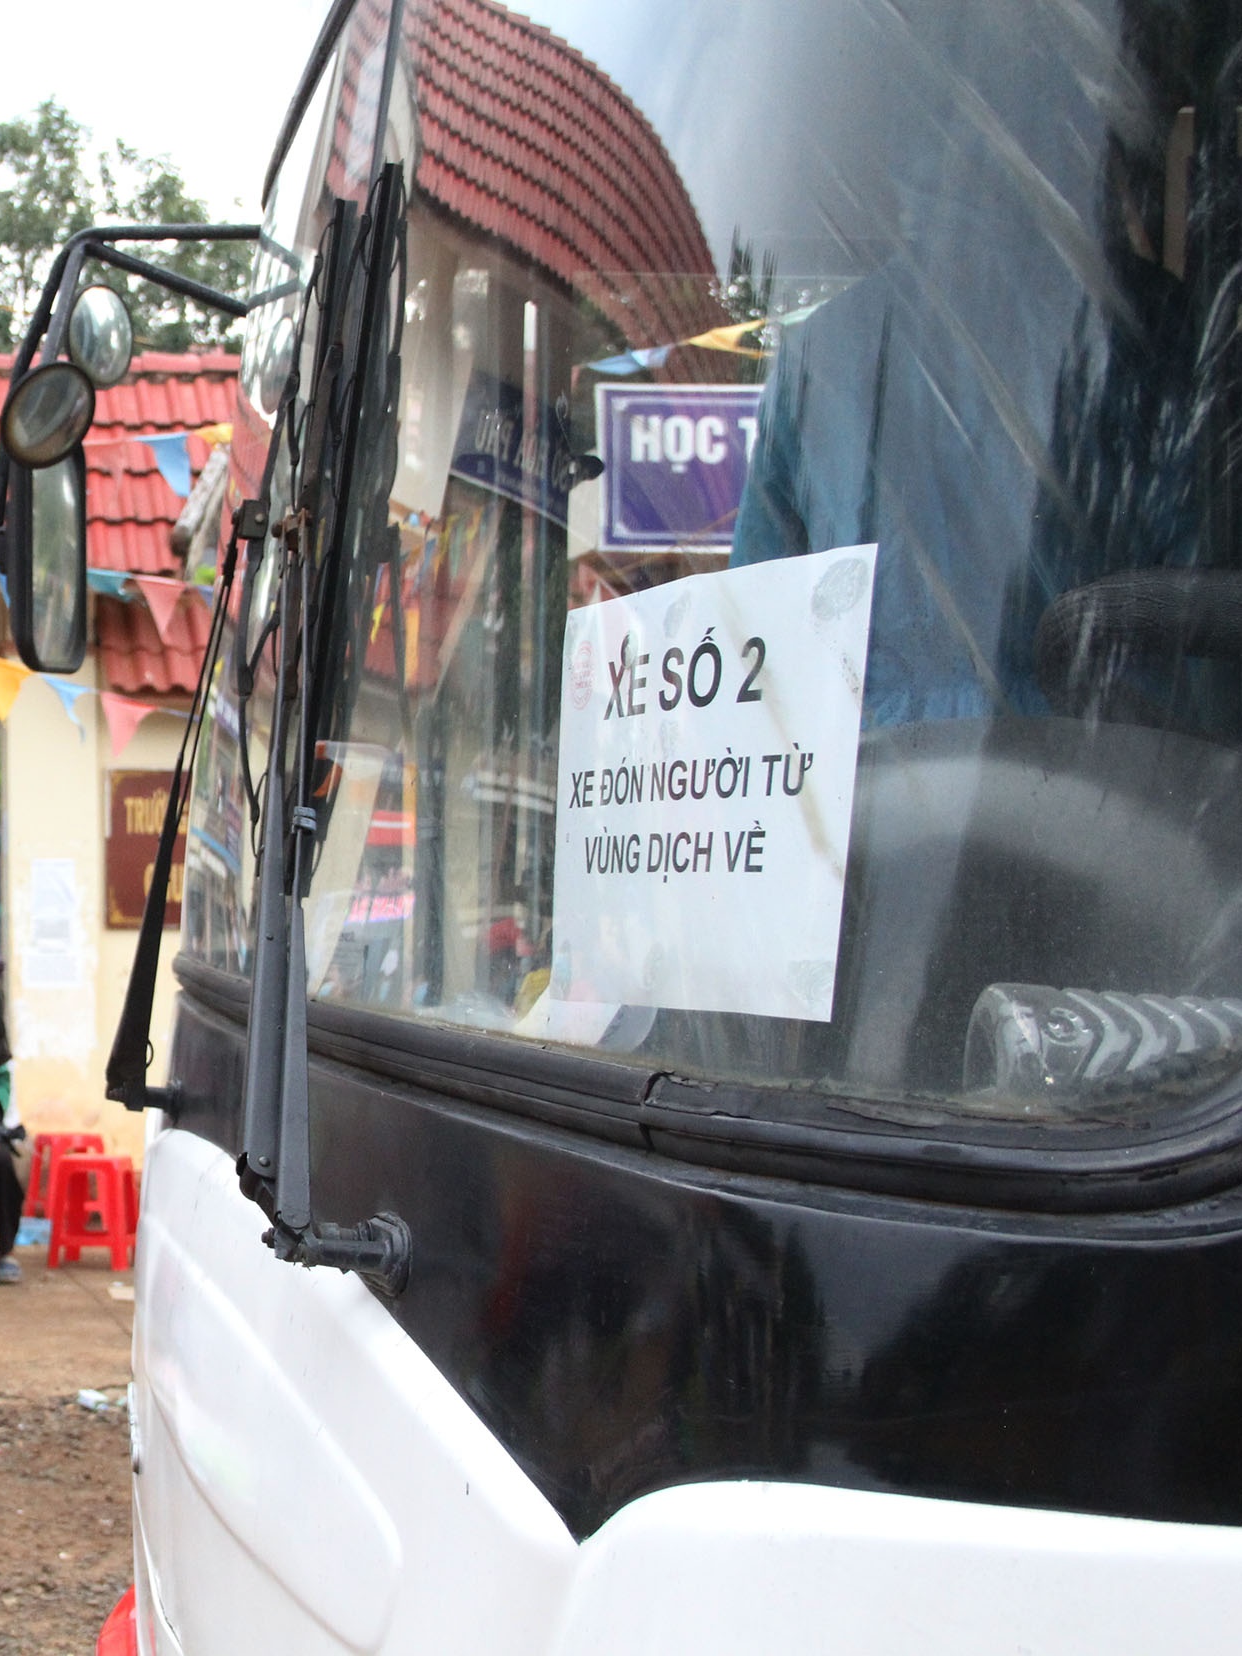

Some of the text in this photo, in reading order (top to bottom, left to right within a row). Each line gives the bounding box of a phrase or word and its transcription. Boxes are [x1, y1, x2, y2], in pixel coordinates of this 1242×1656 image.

[630, 414, 727, 473] HỌC
[604, 650, 649, 720] XE
[659, 627, 722, 712] SỐ
[737, 637, 766, 703] 2
[569, 743, 813, 809] XE ĐÓN NGƯỜI TỪ
[585, 820, 766, 883] VÙNG DỊCH VỀ
